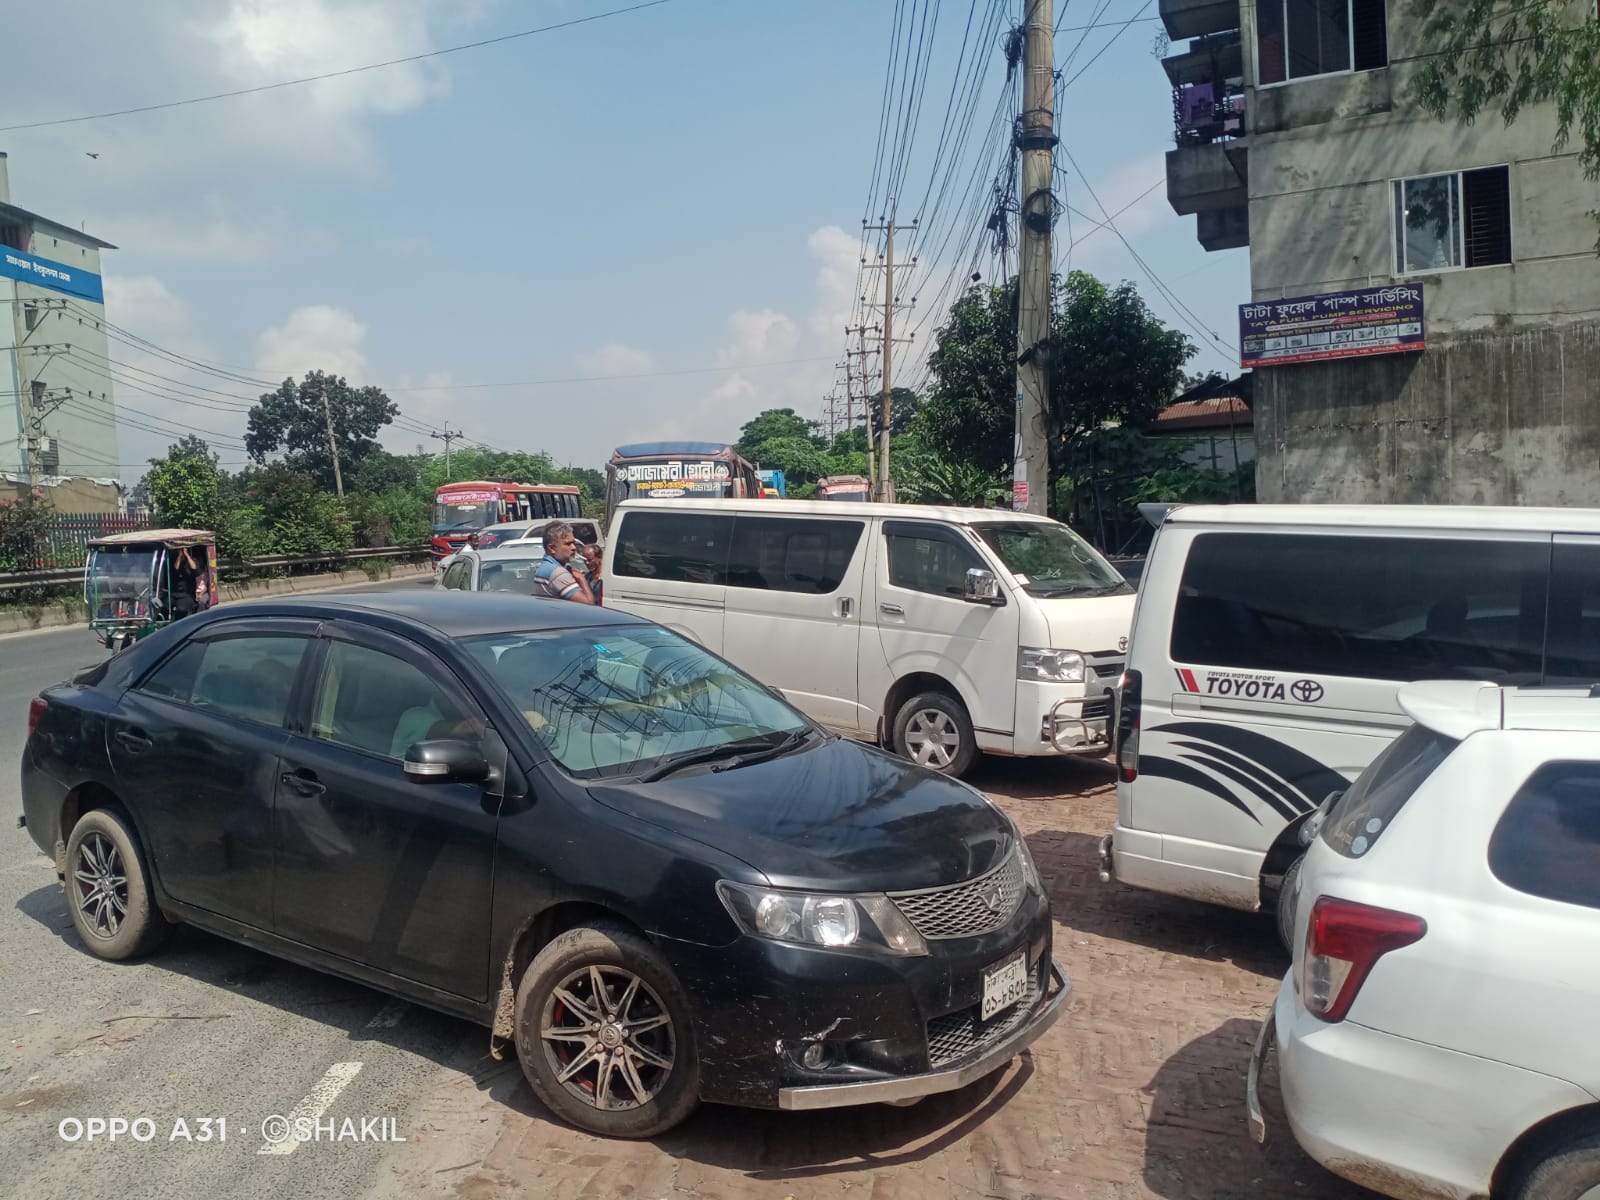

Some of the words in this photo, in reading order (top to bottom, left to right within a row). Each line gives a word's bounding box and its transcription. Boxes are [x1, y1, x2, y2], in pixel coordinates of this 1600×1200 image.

[1243, 304, 1272, 319] টাটা
[1275, 301, 1317, 319] ফুয়েল
[1322, 295, 1359, 310] পাম্প
[1361, 286, 1421, 305] সার্ভিসিং
[1280, 316, 1309, 324] FUEL
[1312, 311, 1345, 320] PUMP
[1349, 303, 1414, 317] SERVICING
[1206, 677, 1286, 700] TOYOTA
